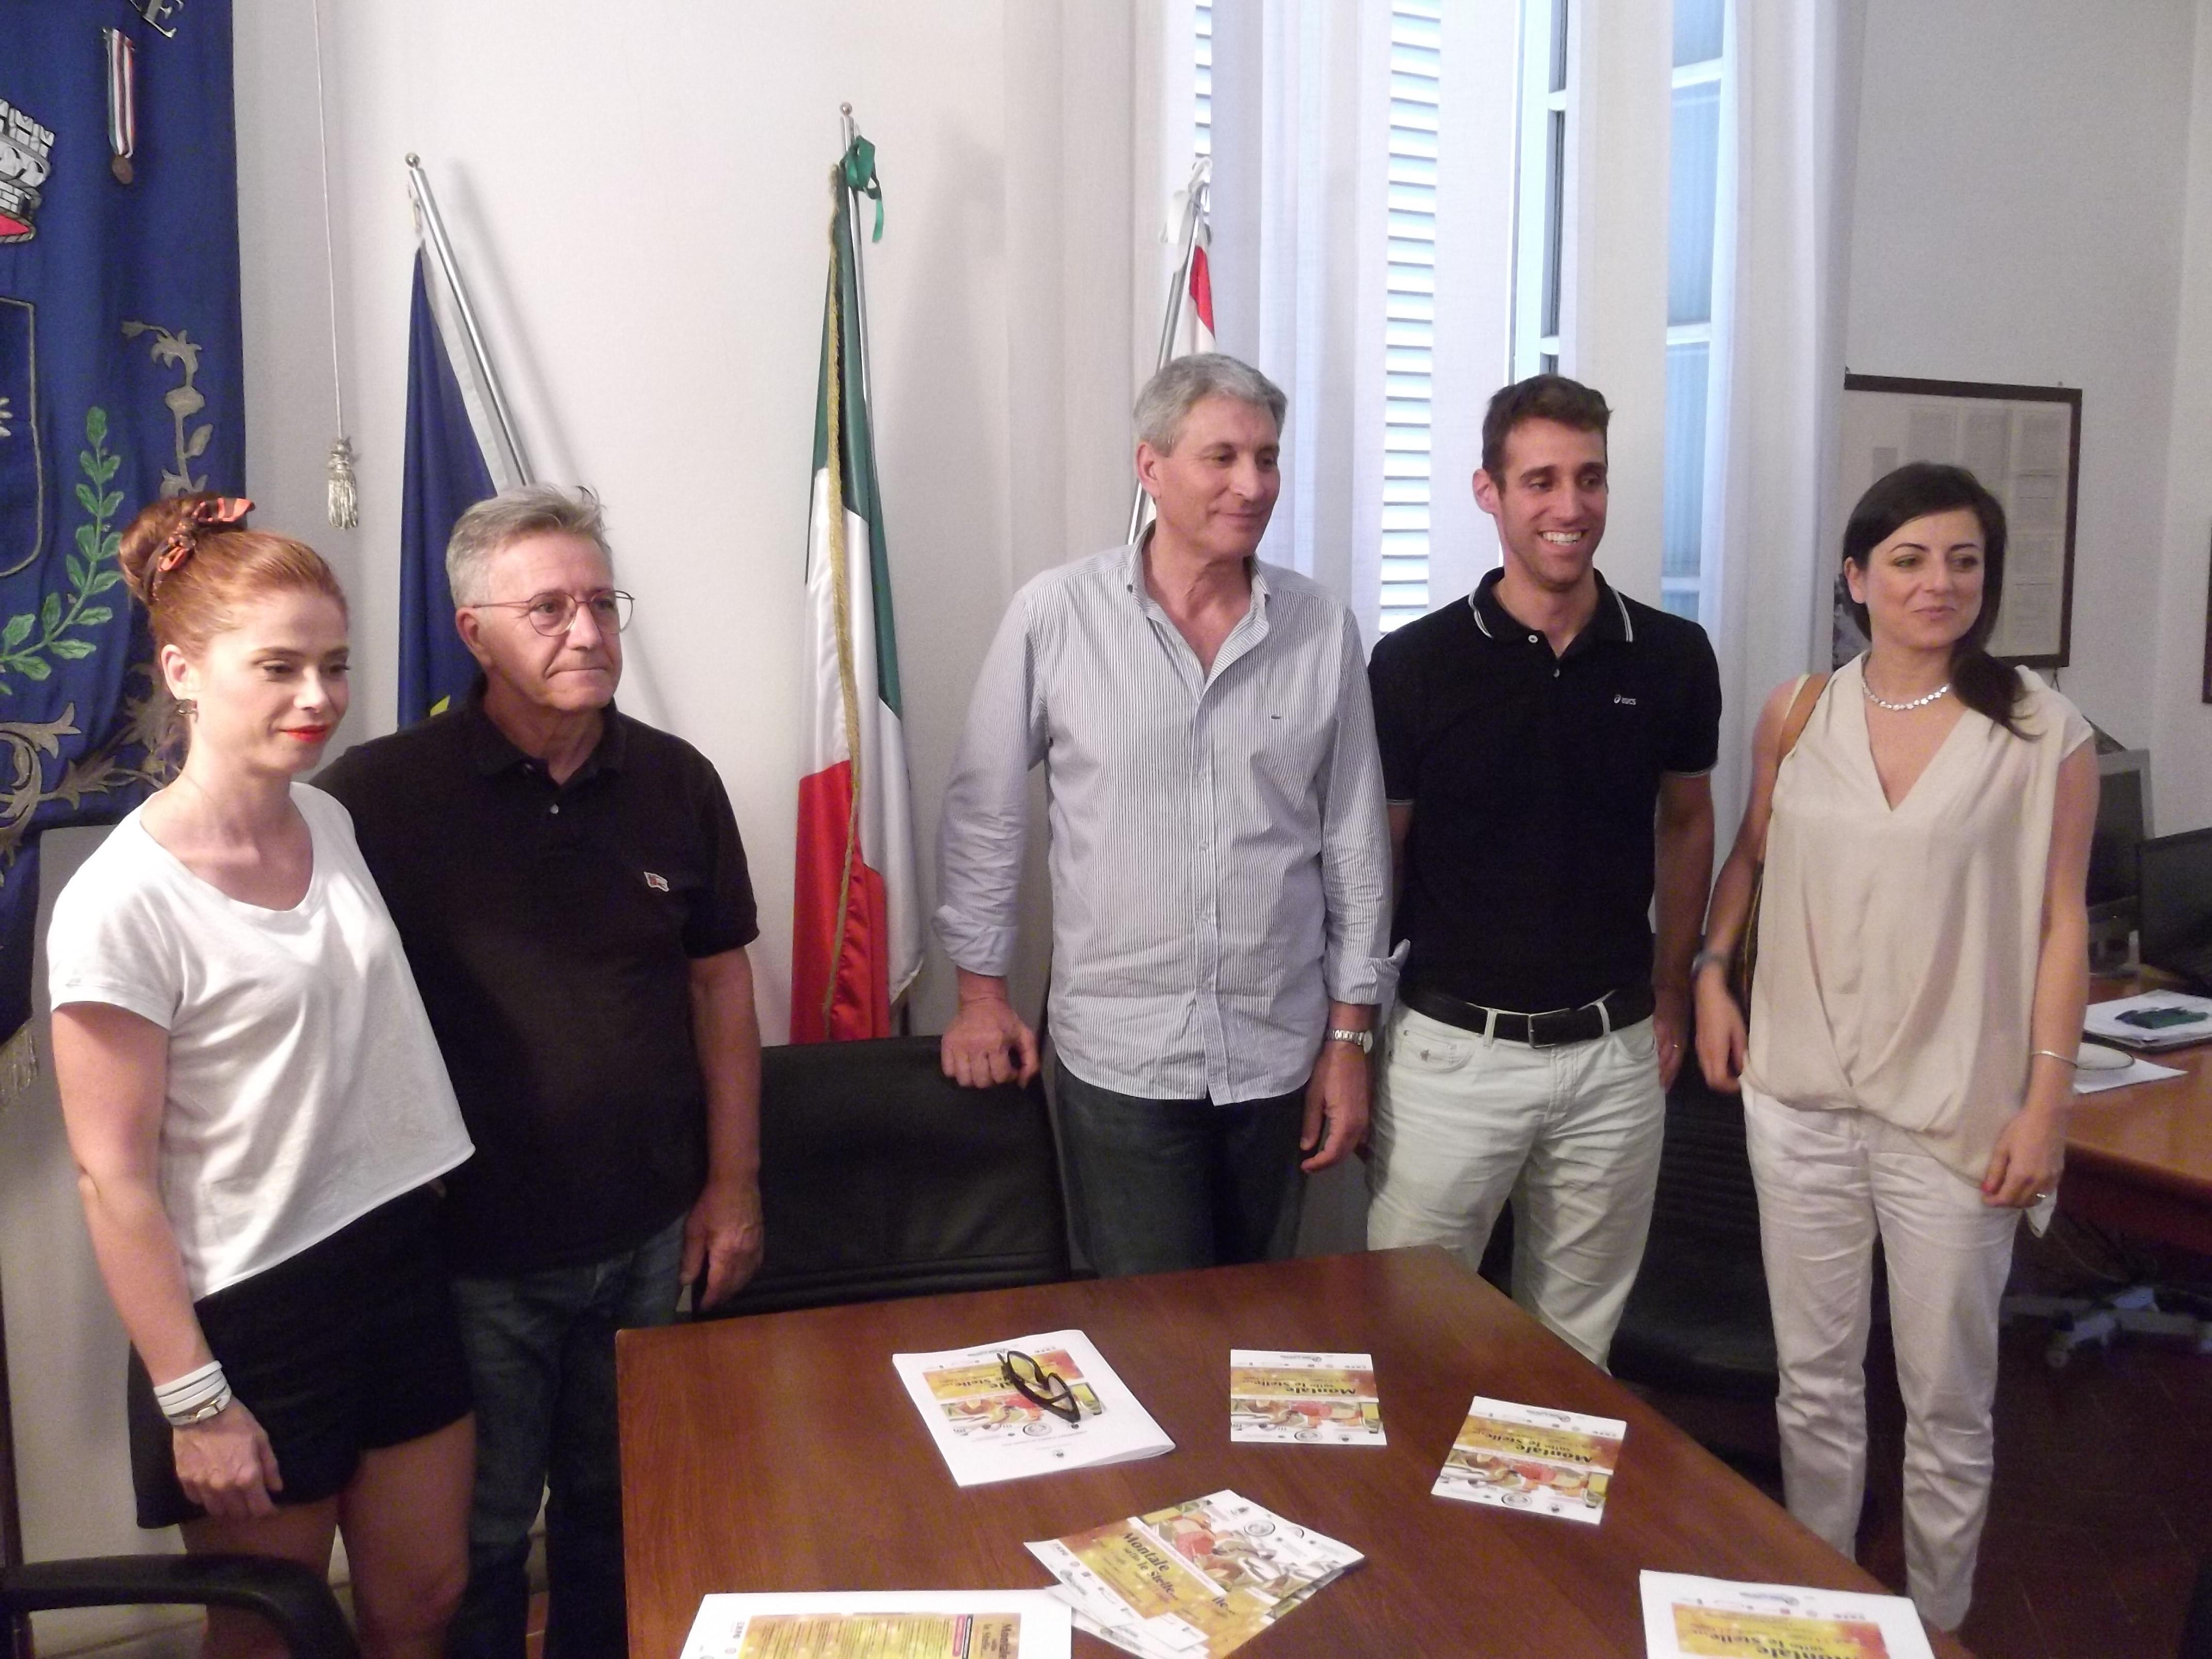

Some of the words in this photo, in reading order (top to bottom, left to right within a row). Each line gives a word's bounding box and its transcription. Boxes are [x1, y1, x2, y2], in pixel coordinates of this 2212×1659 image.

[1516, 1445, 1592, 1462] Montale
[1124, 1532, 1169, 1571] Montale
[1137, 1561, 1148, 1570] le
